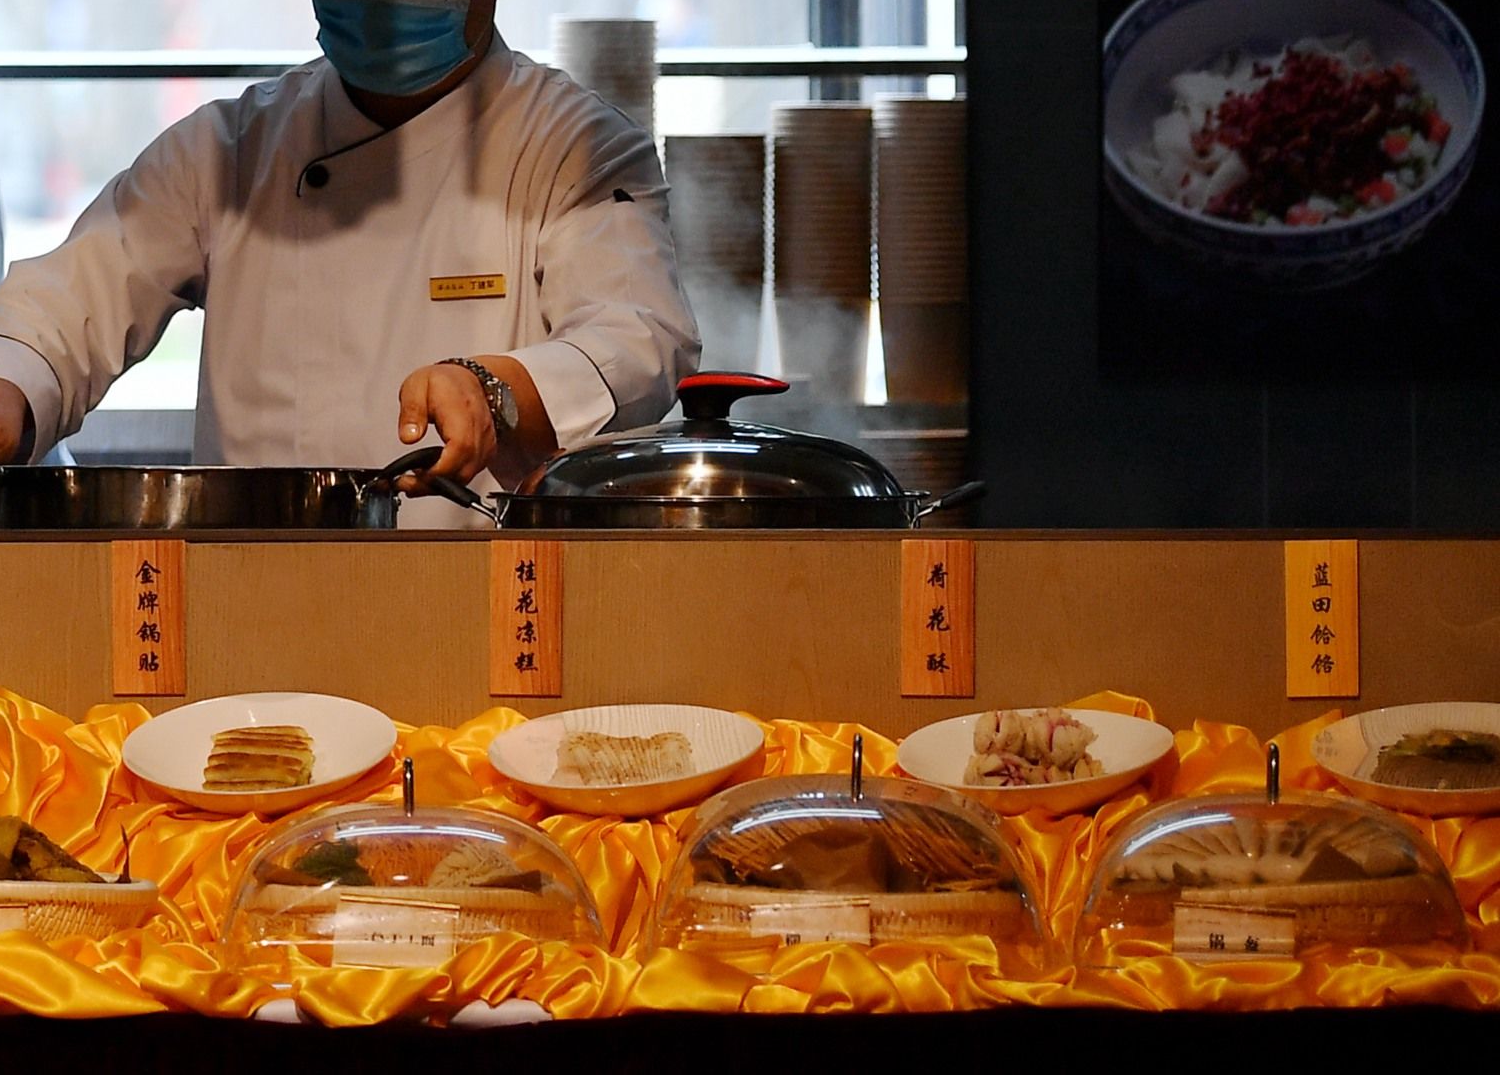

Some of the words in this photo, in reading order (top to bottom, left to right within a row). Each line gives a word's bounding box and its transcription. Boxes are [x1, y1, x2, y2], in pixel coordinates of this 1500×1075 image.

[135, 560, 161, 672] 金牌锅贴
[514, 559, 539, 673] 桂花凉糕
[926, 562, 950, 673] 荷花酥
[1310, 562, 1335, 674] 蓝田饸饹
